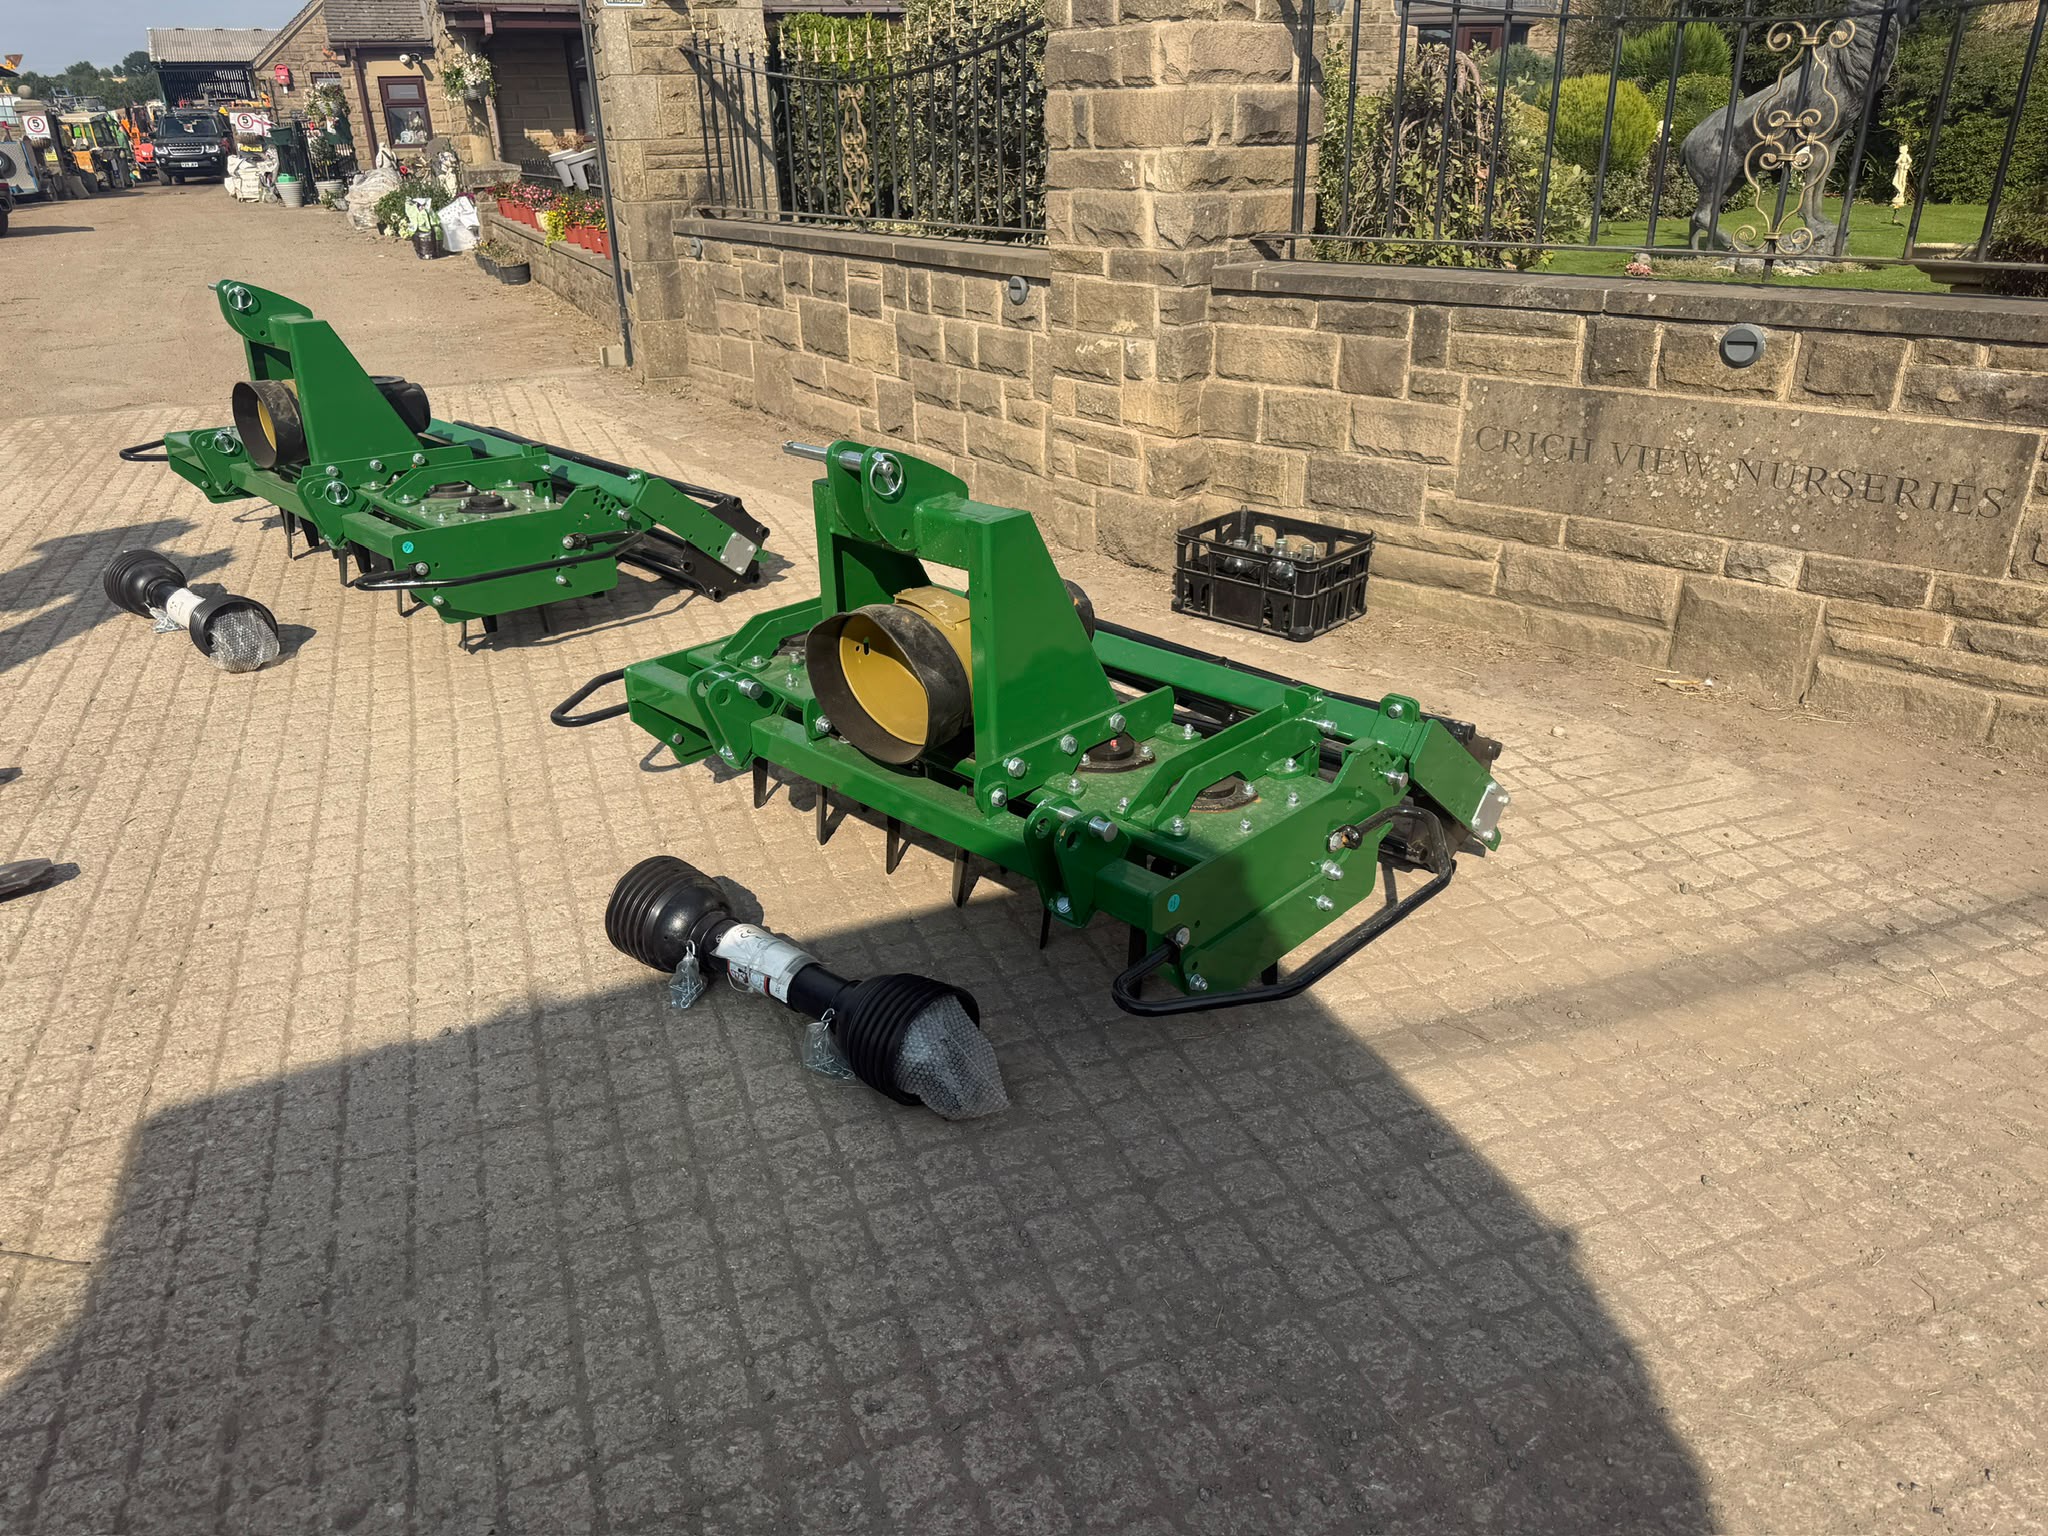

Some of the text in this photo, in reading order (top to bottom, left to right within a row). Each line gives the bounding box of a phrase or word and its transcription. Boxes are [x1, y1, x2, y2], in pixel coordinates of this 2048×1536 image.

[32, 119, 40, 128] 5
[241, 115, 249, 124] 5
[1475, 426, 2007, 518] CRICH VIEW NURSERIES
